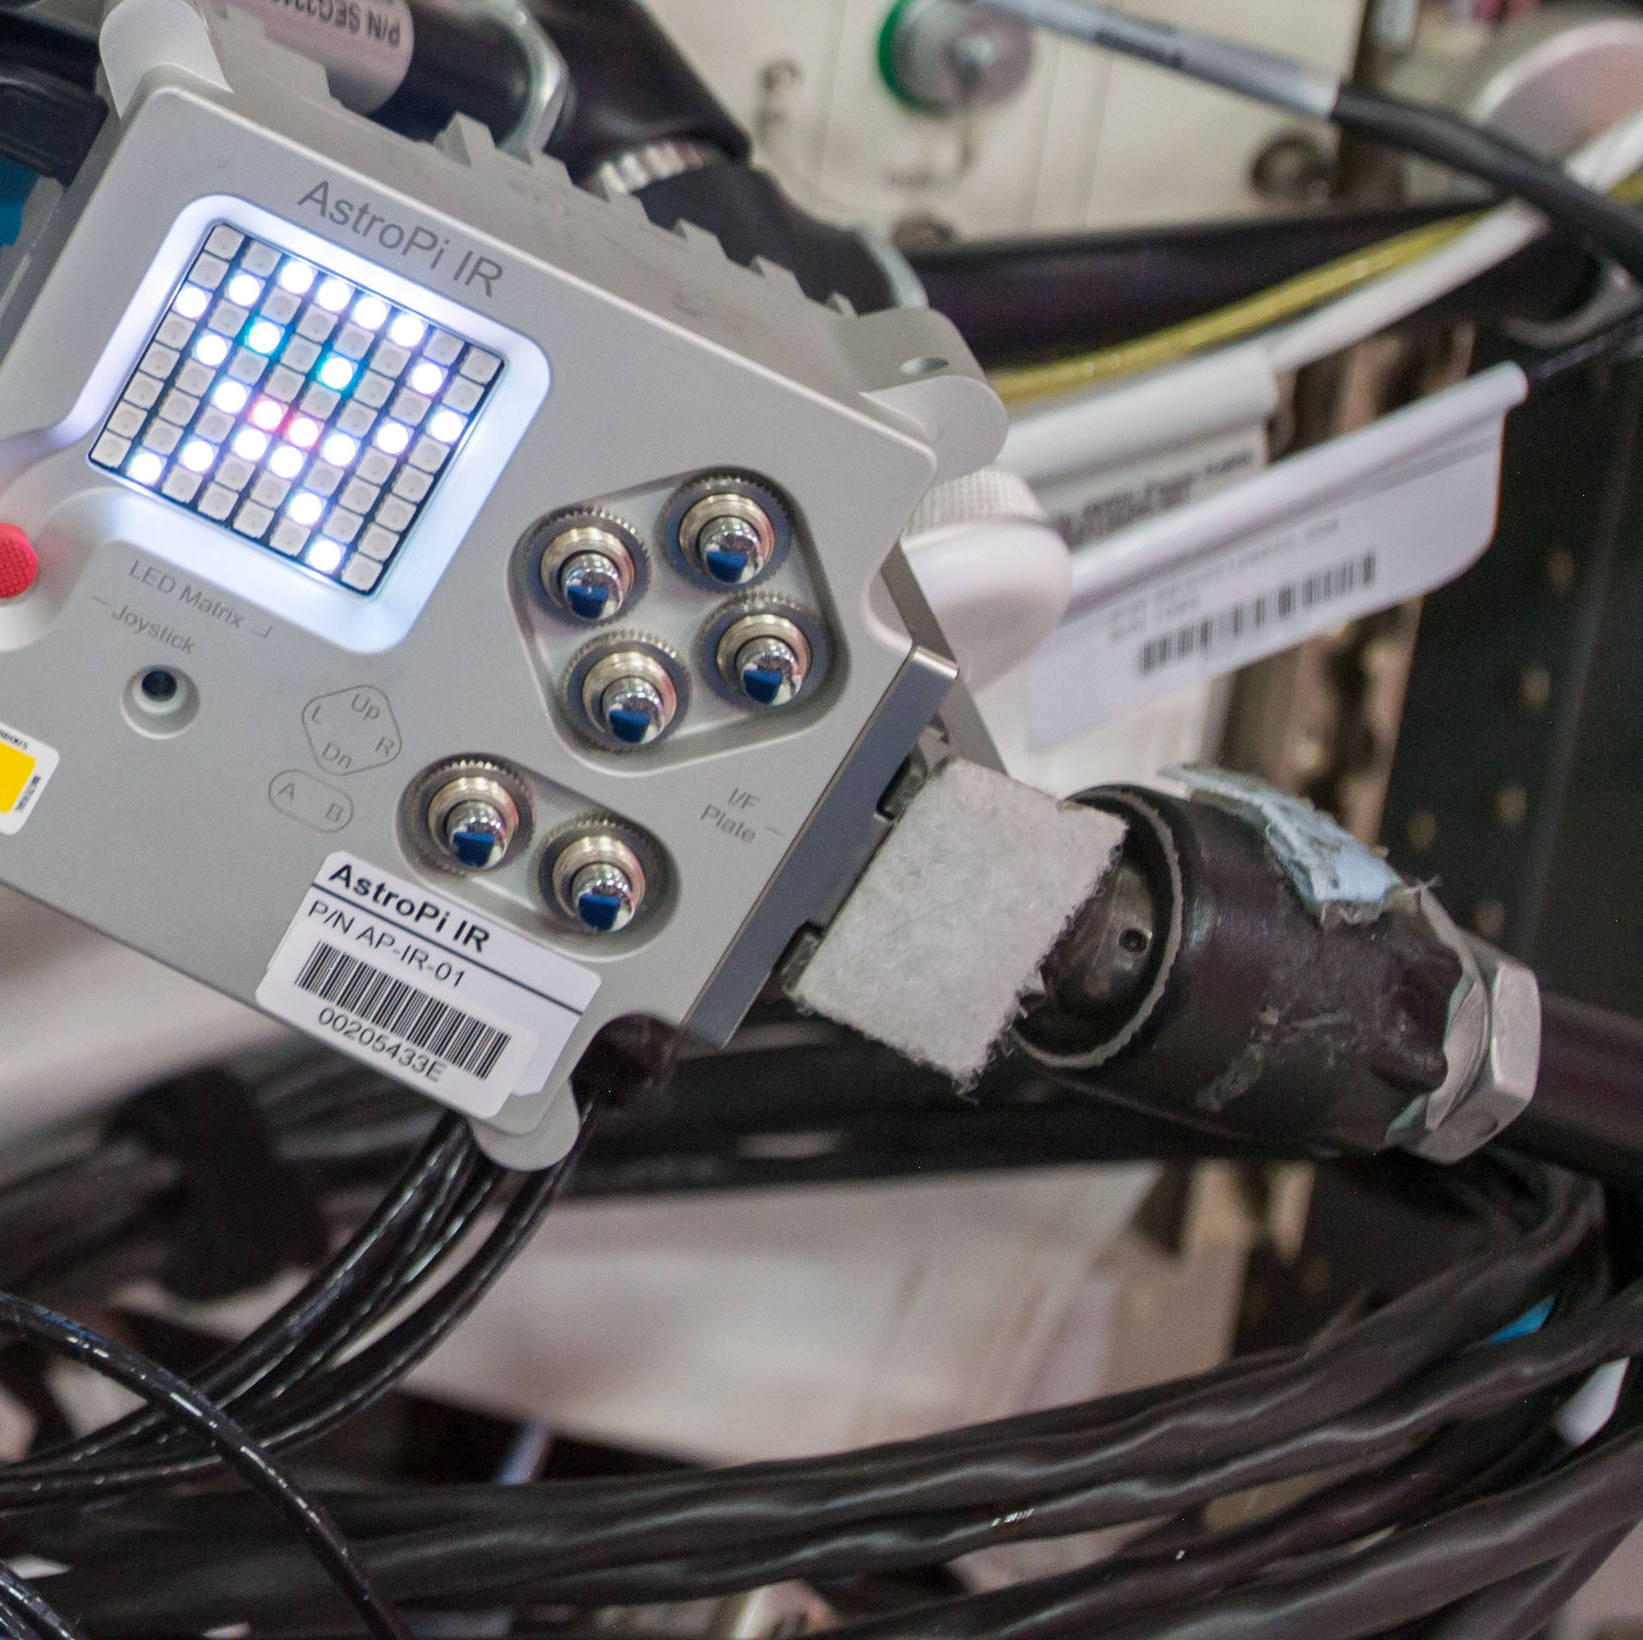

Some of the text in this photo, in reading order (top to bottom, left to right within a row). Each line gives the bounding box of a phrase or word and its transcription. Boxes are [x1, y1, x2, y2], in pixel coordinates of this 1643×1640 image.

[366, 9, 402, 48] P/N
[296, 180, 504, 298] AstroPi IR
[127, 559, 245, 630] LED Matrix
[112, 604, 197, 656] Joystick
[351, 693, 381, 722] Up
[321, 741, 353, 770] Dn
[374, 736, 396, 758] R
[278, 782, 297, 801] A
[726, 786, 762, 812] I/F
[699, 803, 758, 846] Plate
[328, 862, 492, 954] AstroPi IR
[307, 899, 467, 990] P/N AP-IR-01
[317, 1006, 445, 1085] 00205433E
